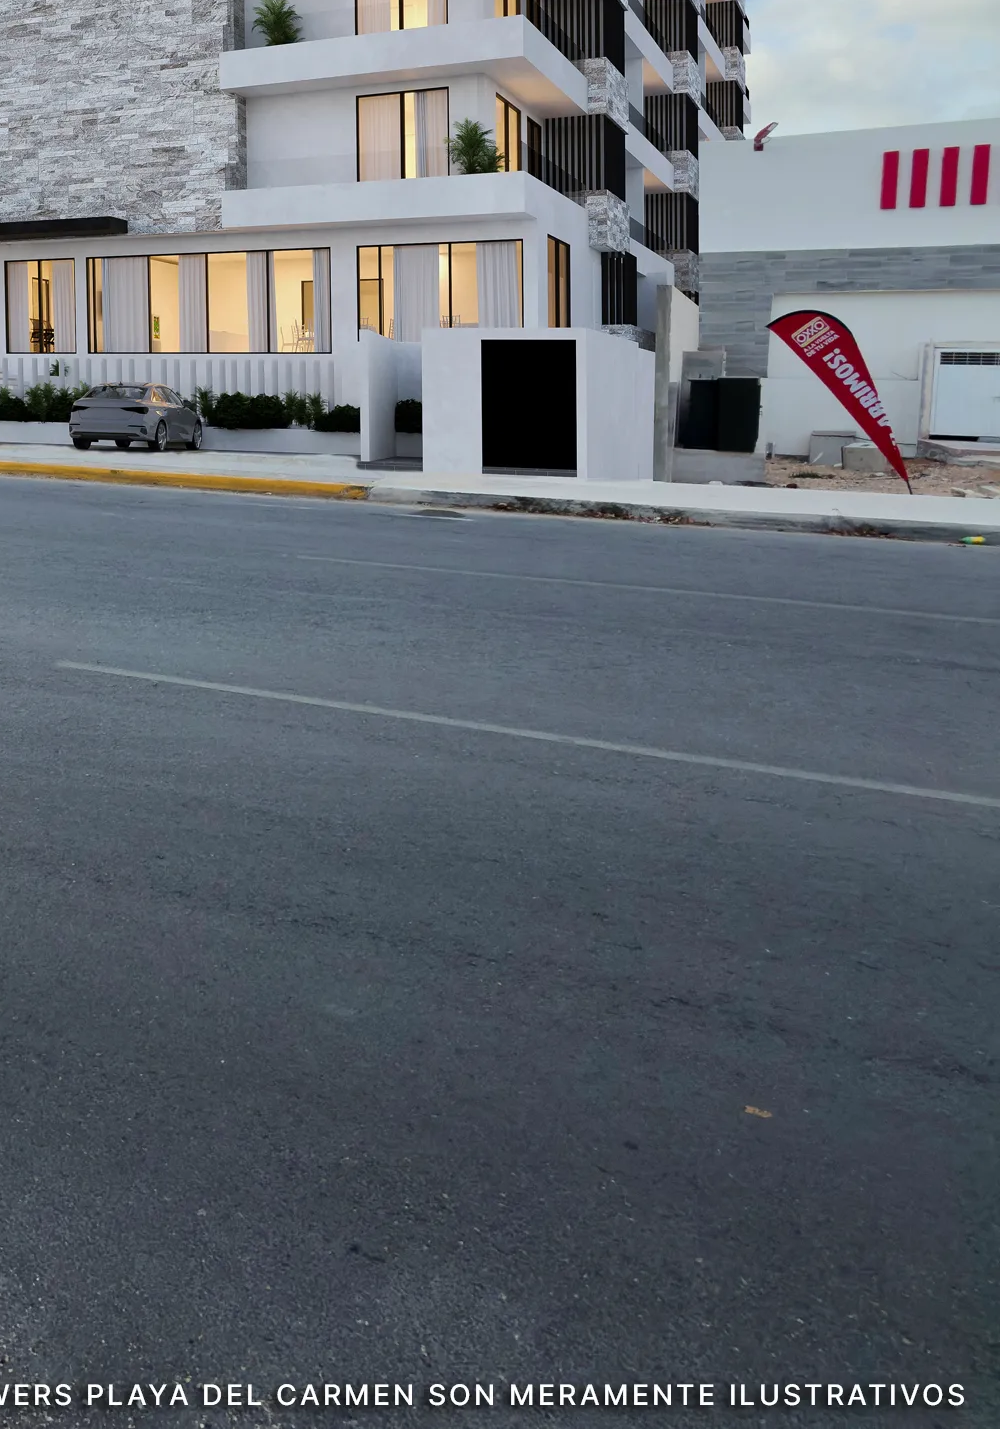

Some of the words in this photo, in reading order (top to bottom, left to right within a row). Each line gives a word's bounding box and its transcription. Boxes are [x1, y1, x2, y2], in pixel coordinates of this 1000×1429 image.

[796, 321, 825, 343] OXXO
[814, 330, 836, 344] VUELTA
[806, 349, 817, 358] DE
[814, 343, 825, 351] TU
[823, 334, 841, 346] VIDA
